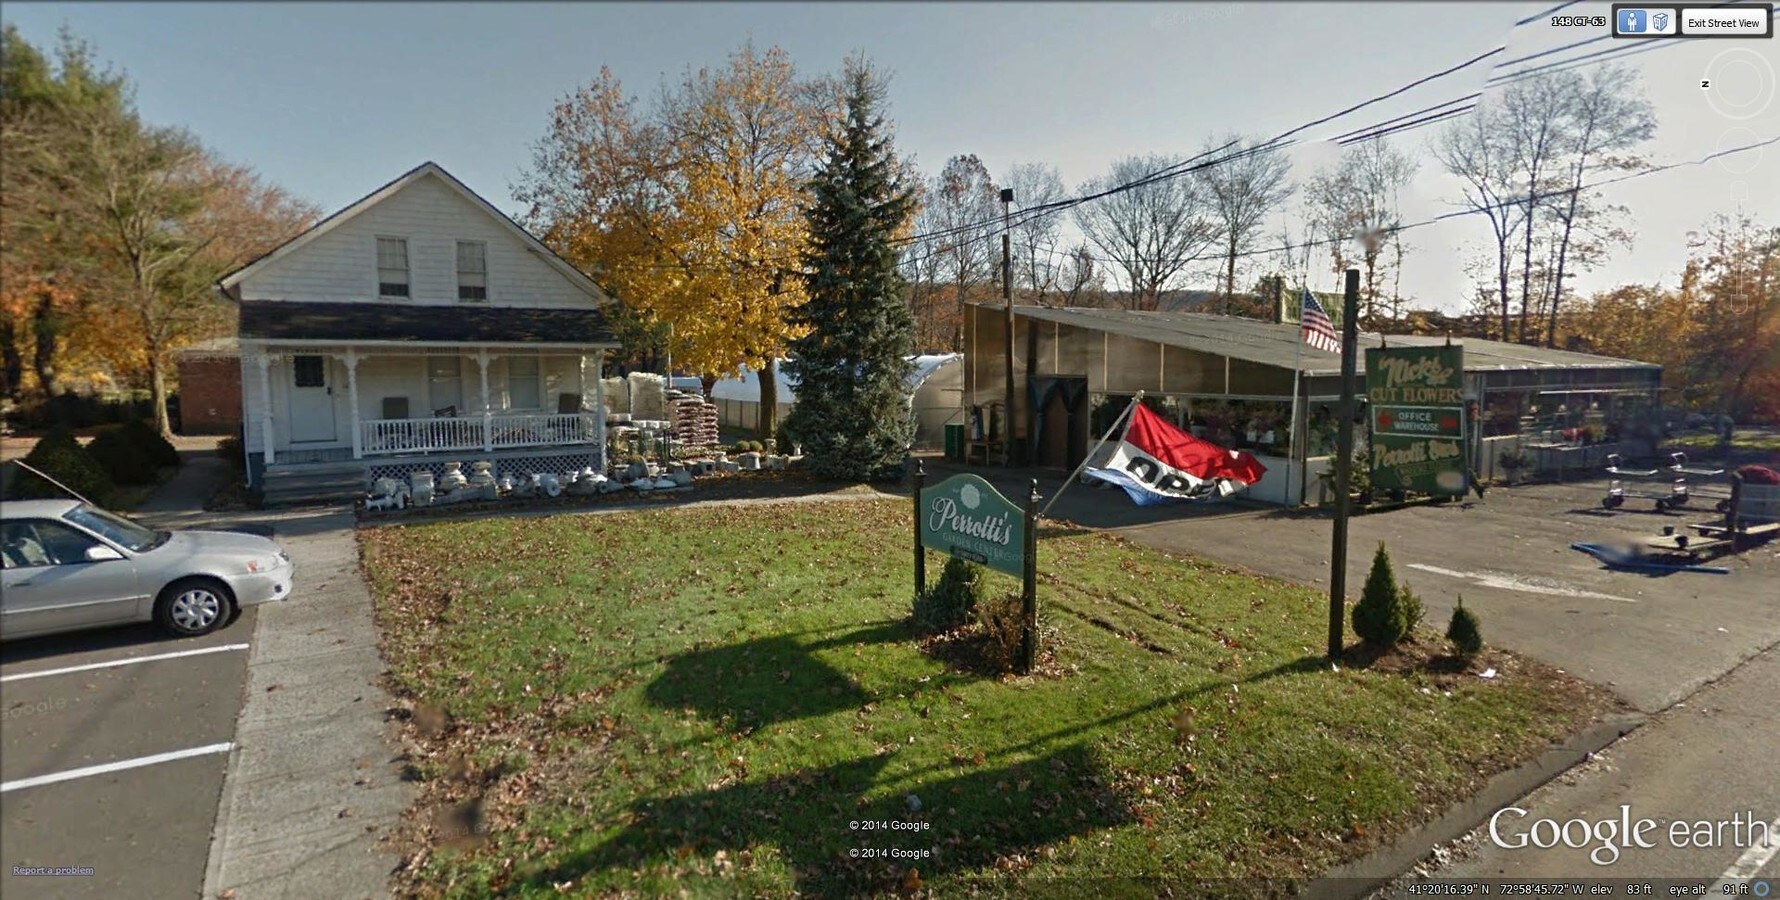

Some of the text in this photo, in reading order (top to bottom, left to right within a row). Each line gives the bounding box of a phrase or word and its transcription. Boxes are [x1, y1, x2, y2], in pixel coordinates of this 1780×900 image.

[1370, 387, 1464, 402] CUT FLOWERS
[1398, 412, 1432, 421] OFFICE
[1393, 421, 1440, 432] WAREHOUSE
[930, 497, 1012, 545] Perrotti's
[942, 532, 972, 549] GARDEN
[974, 542, 1005, 560] CENTER
